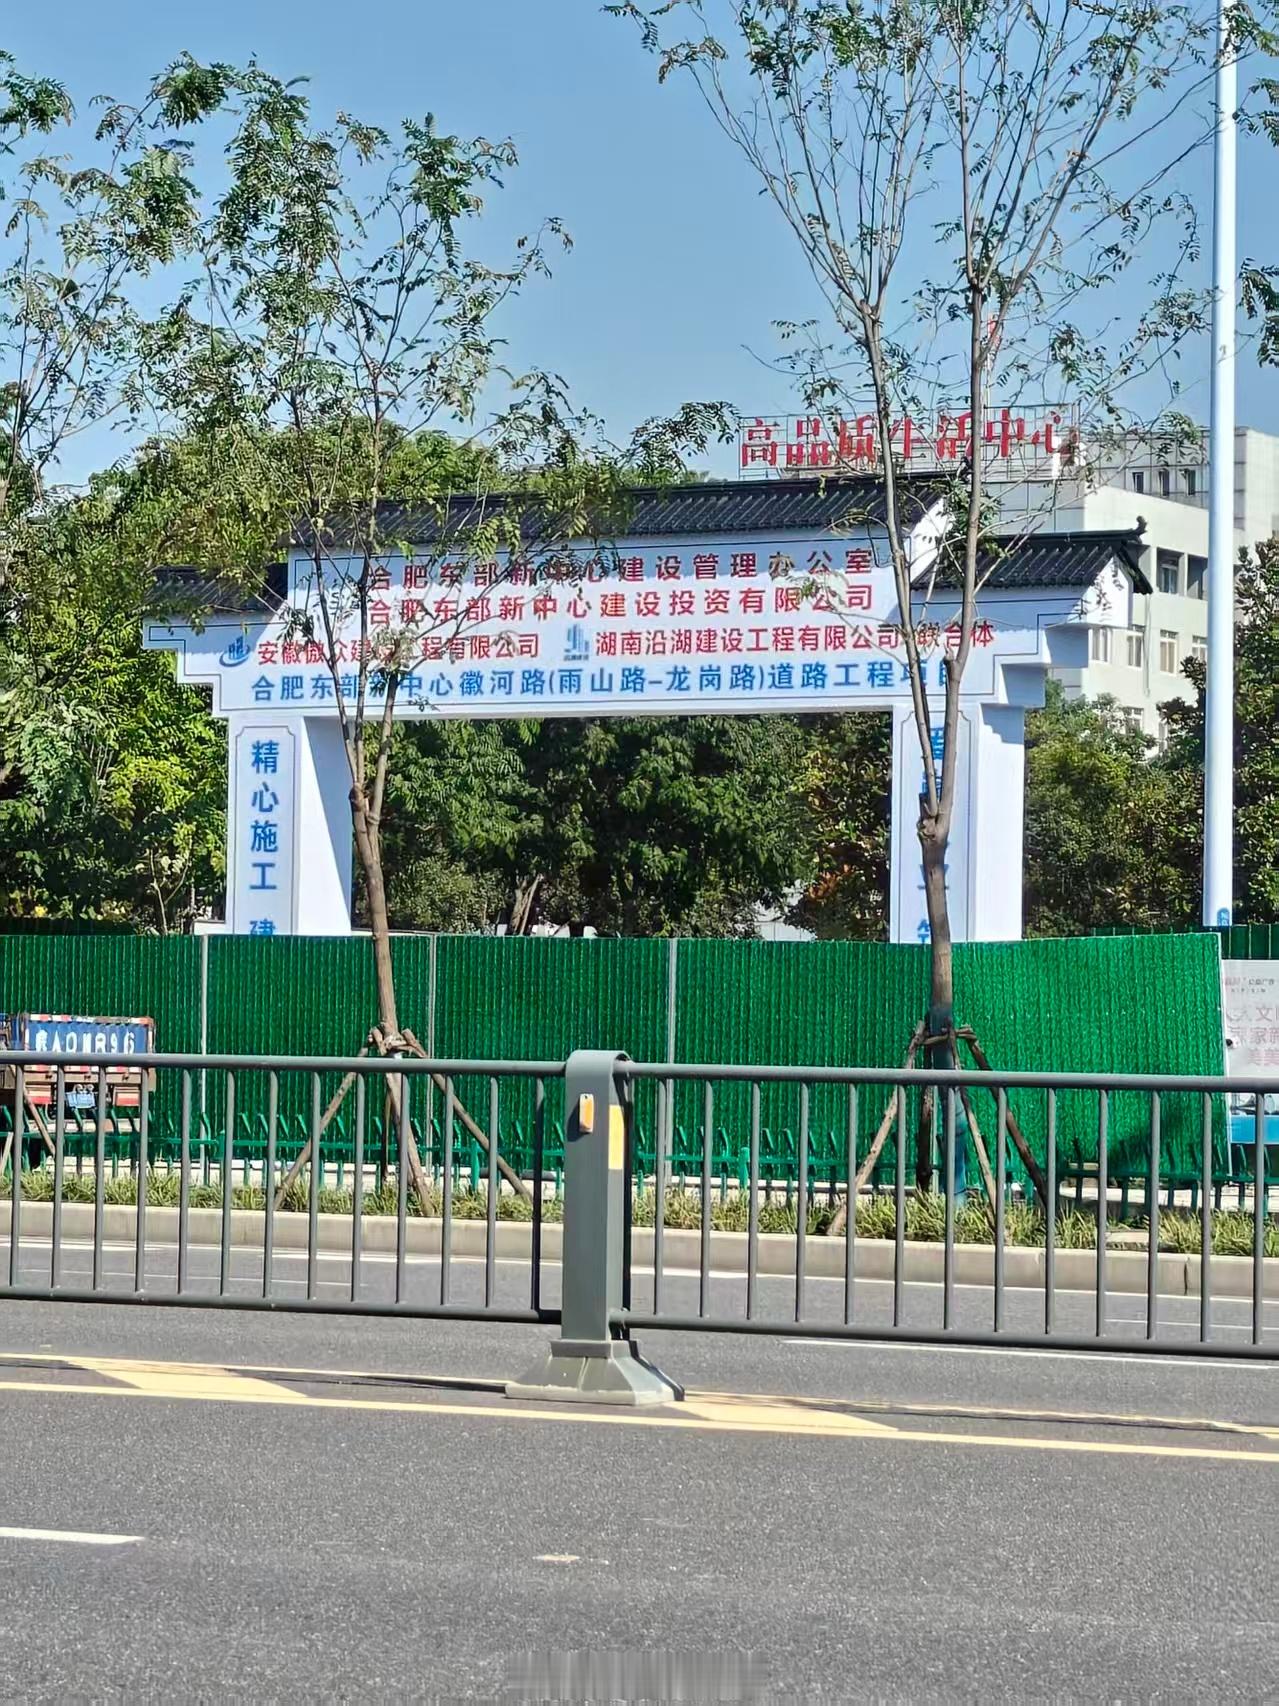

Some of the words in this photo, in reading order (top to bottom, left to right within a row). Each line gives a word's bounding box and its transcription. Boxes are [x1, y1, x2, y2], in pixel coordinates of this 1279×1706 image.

[368, 584, 873, 625] 合肥东部新中心建设投资有限公司
[596, 625, 899, 656] 湖南沿湖建设工程有限公司
[250, 740, 280, 891] 精心施工
